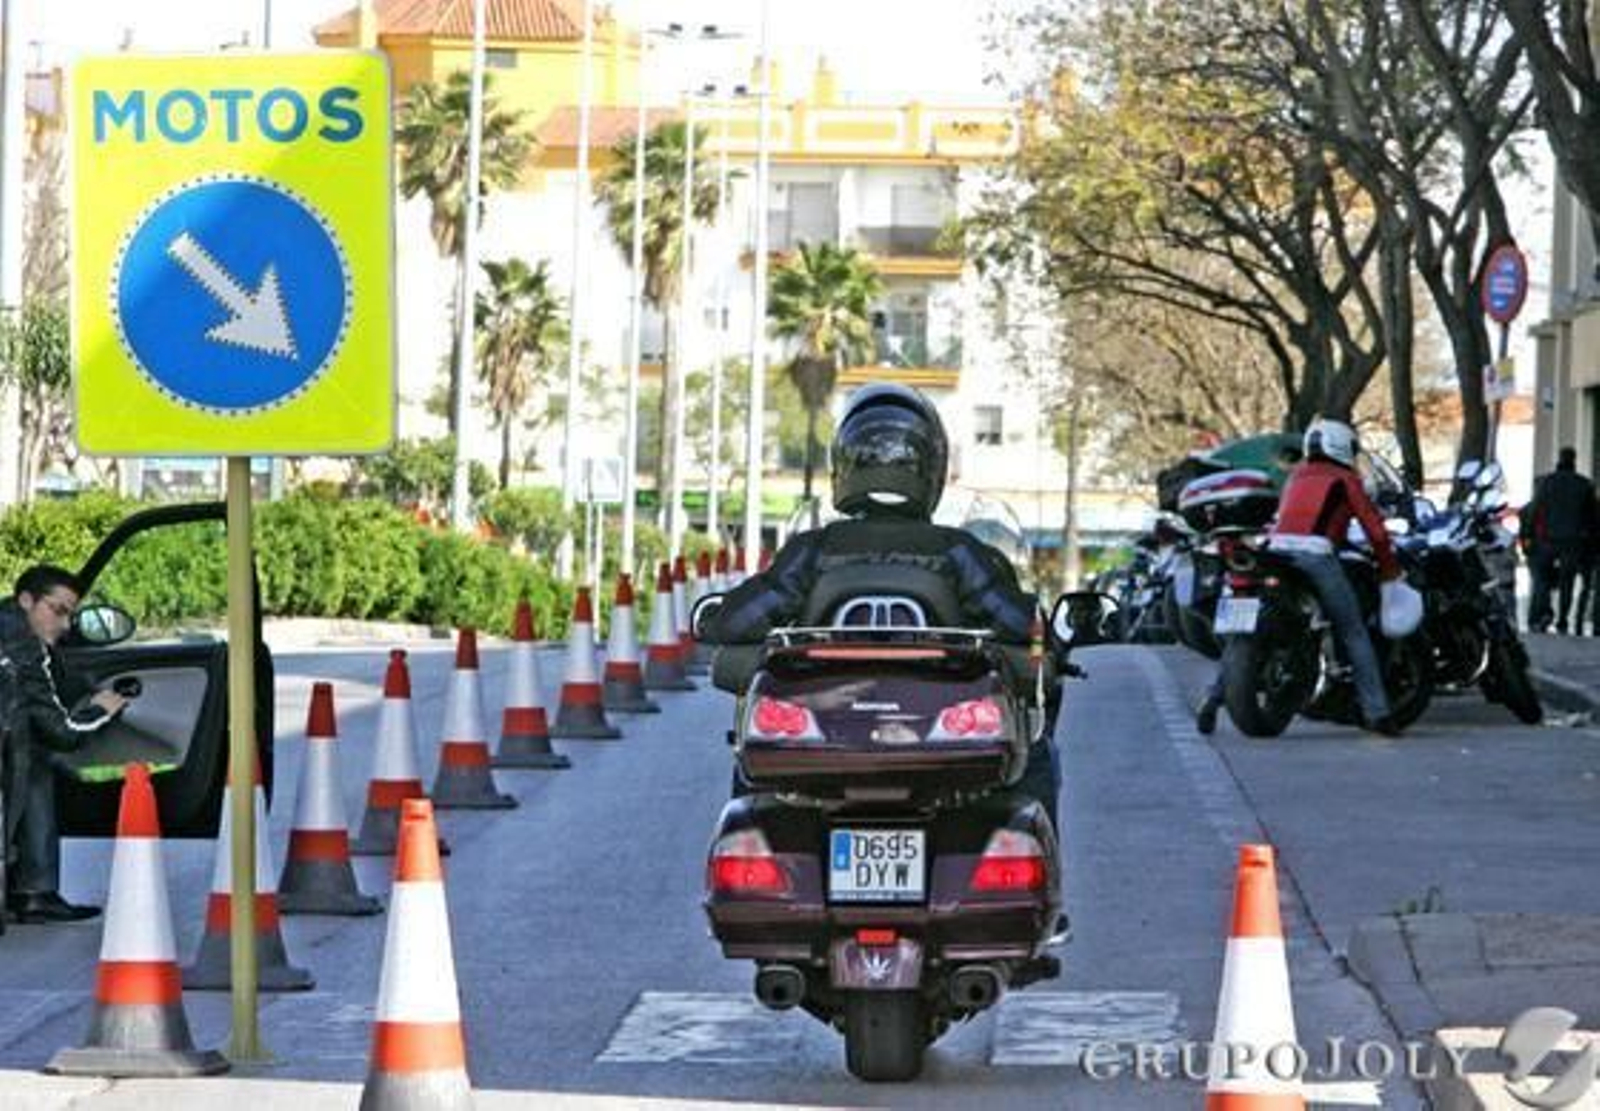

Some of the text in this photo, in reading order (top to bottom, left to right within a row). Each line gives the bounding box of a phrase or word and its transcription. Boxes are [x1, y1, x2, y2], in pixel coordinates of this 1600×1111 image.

[92, 86, 364, 143] MOTOS
[854, 835, 918, 860] 0695
[856, 862, 910, 888] DYW
